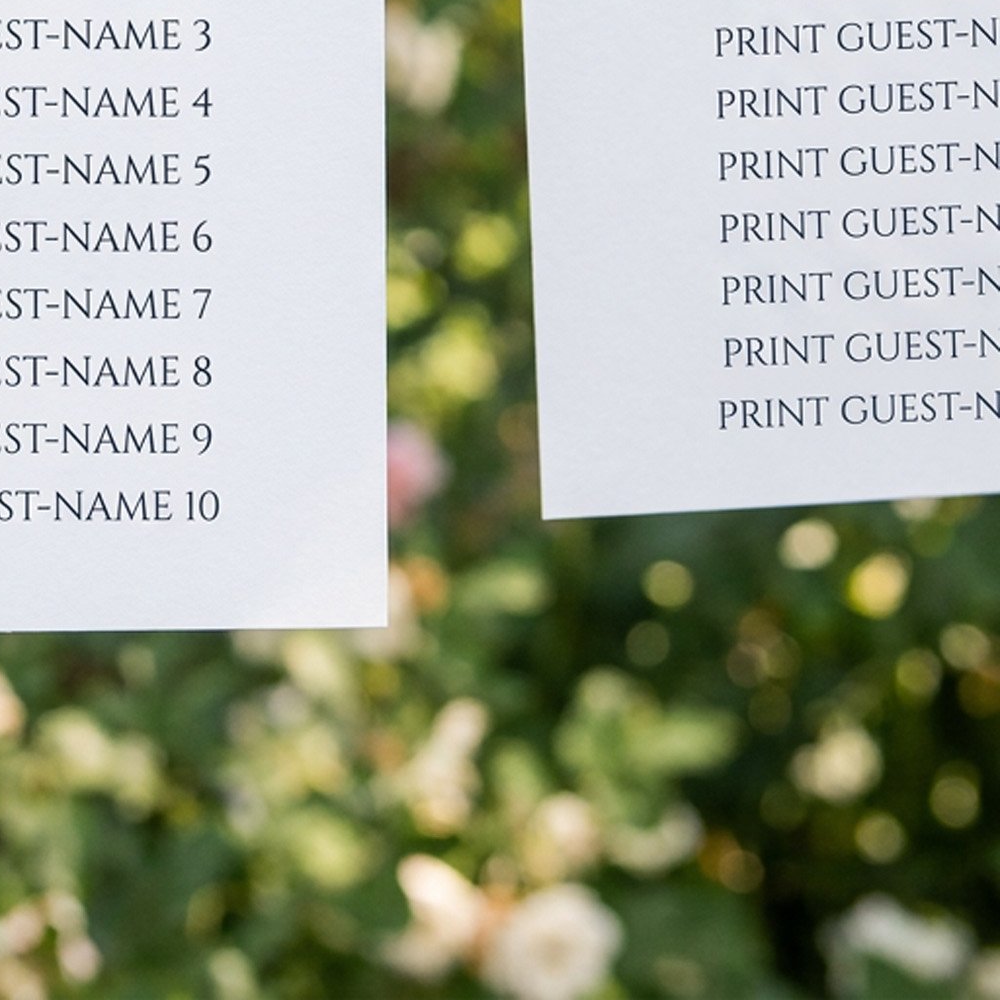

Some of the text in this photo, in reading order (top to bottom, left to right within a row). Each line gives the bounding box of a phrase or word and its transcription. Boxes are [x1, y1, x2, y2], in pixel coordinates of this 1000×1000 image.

[193, 19, 211, 52] 3
[715, 17, 997, 57] PRINT GUEST-N
[192, 87, 213, 118] 4
[717, 79, 999, 119] PRINT GUEST-N
[194, 154, 211, 186] 5
[719, 141, 1000, 181] PRINT GUEST-N
[192, 220, 213, 253] 6
[720, 203, 1000, 243] PRINT GUEST-N
[722, 266, 1000, 306] PRINT GUEST-N
[192, 288, 212, 319] 7
[724, 329, 1000, 368] PRINT GUEST-N
[192, 355, 212, 387] 8
[719, 390, 1000, 430] PRINT GUEST-N
[192, 423, 212, 455] 9
[186, 490, 220, 522] 10
